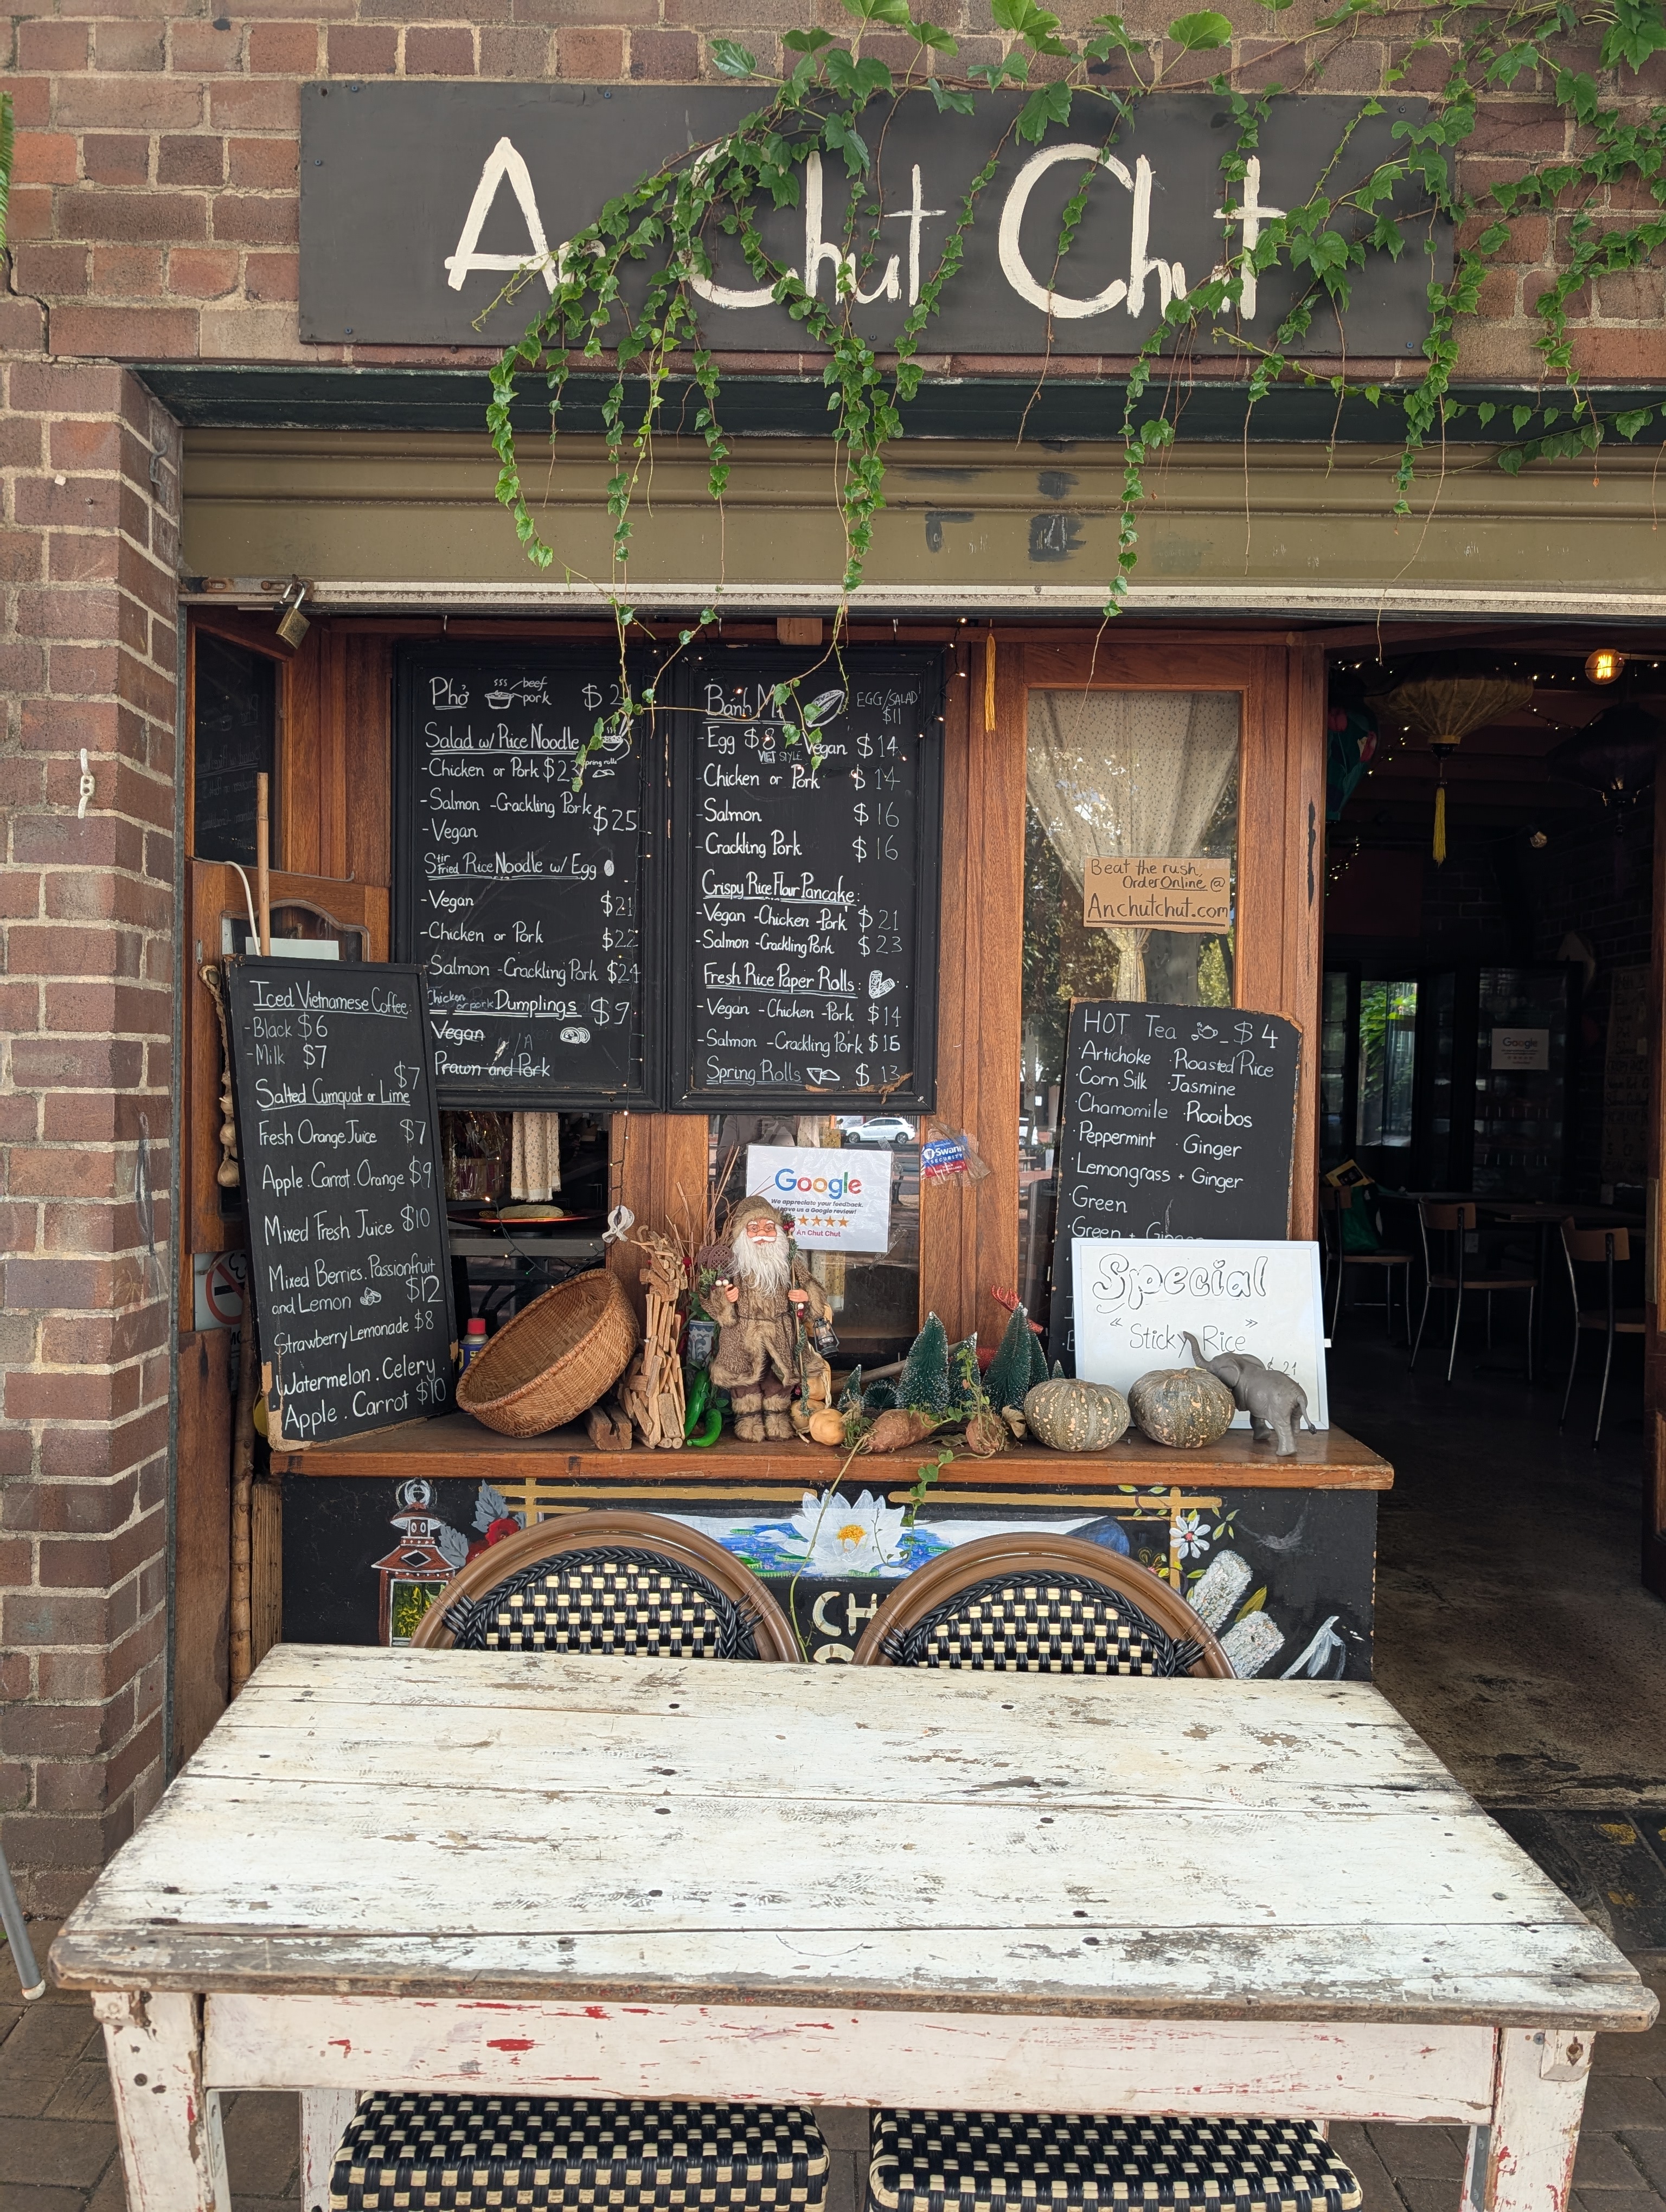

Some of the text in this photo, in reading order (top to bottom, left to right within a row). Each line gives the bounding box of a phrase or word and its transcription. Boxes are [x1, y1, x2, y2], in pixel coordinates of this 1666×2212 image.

[523, 676, 548, 690] beef
[523, 691, 552, 706] pork
[425, 722, 579, 750] Salad w/ Rice Noodle
[493, 767, 505, 776] or
[510, 757, 540, 778] Pork
[770, 763, 820, 789] or Pork
[560, 792, 592, 814] Pork
[593, 805, 637, 835] $25
[771, 829, 803, 856] Pork
[437, 862, 459, 875] Fried
[462, 852, 493, 873] Rice
[495, 851, 542, 874] Noodle
[572, 853, 597, 880] Egg
[1091, 858, 1203, 877] Beat the rush,
[702, 869, 744, 899] Crispy
[746, 871, 772, 896] Rice
[773, 871, 800, 898] Flour
[1123, 876, 1225, 892] Order Online @
[600, 890, 633, 917] $21
[1088, 893, 1228, 918] Anchutchut.com
[494, 932, 507, 942] or
[512, 921, 543, 943] Pork
[602, 928, 639, 951] $22
[808, 934, 835, 954] Pork
[569, 958, 599, 982] Pork
[704, 962, 741, 986] Fresh
[744, 962, 775, 987] Rice
[777, 963, 813, 993] Paper
[249, 980, 295, 1007] Iced
[296, 980, 369, 1012] Vietnamese
[494, 989, 576, 1020] Dumplings
[431, 1020, 484, 1045] Vegan
[1084, 1009, 1177, 1040] HOT Tea
[303, 1043, 327, 1069] $7
[835, 1031, 864, 1054] Pork
[1502, 1037, 1538, 1050] Google
[434, 1050, 550, 1078] Prawn and Pork
[707, 1055, 802, 1086] Spring Rolls
[1081, 1040, 1274, 1078] Artichoke Roasted Rice
[255, 1060, 420, 1109] Salted Cumquat or Lime $7
[1079, 1066, 1236, 1096] Corn Silk Jasmine
[1078, 1092, 1253, 1128] Chamomile Rooibos
[259, 1118, 426, 1149] Fresh Orange Juice $7
[1079, 1120, 1242, 1160] Peppermint Ginger
[931, 1153, 963, 1164] SECURITY
[935, 1145, 965, 1156] Swann
[262, 1155, 432, 1197] Apple Carrot Orange $9
[775, 1168, 862, 1200] Google
[1077, 1152, 1244, 1193] Lemongrass Ginger
[1072, 1185, 1127, 1213] Green
[264, 1203, 430, 1246] Mixed Fresh Juice $10
[1072, 1216, 1121, 1238] Green
[268, 1253, 436, 1292] Mixed Passionfruit
[1093, 1253, 1268, 1310] Special
[272, 1275, 444, 1315] and Lemon $12
[274, 1308, 434, 1355] Strawberry Lemonade $8
[1130, 1323, 1246, 1359] Sticky Rice
[276, 1354, 435, 1396] Watermelon Celery
[285, 1399, 337, 1438] Apple
[353, 1390, 409, 1418] Carrot
